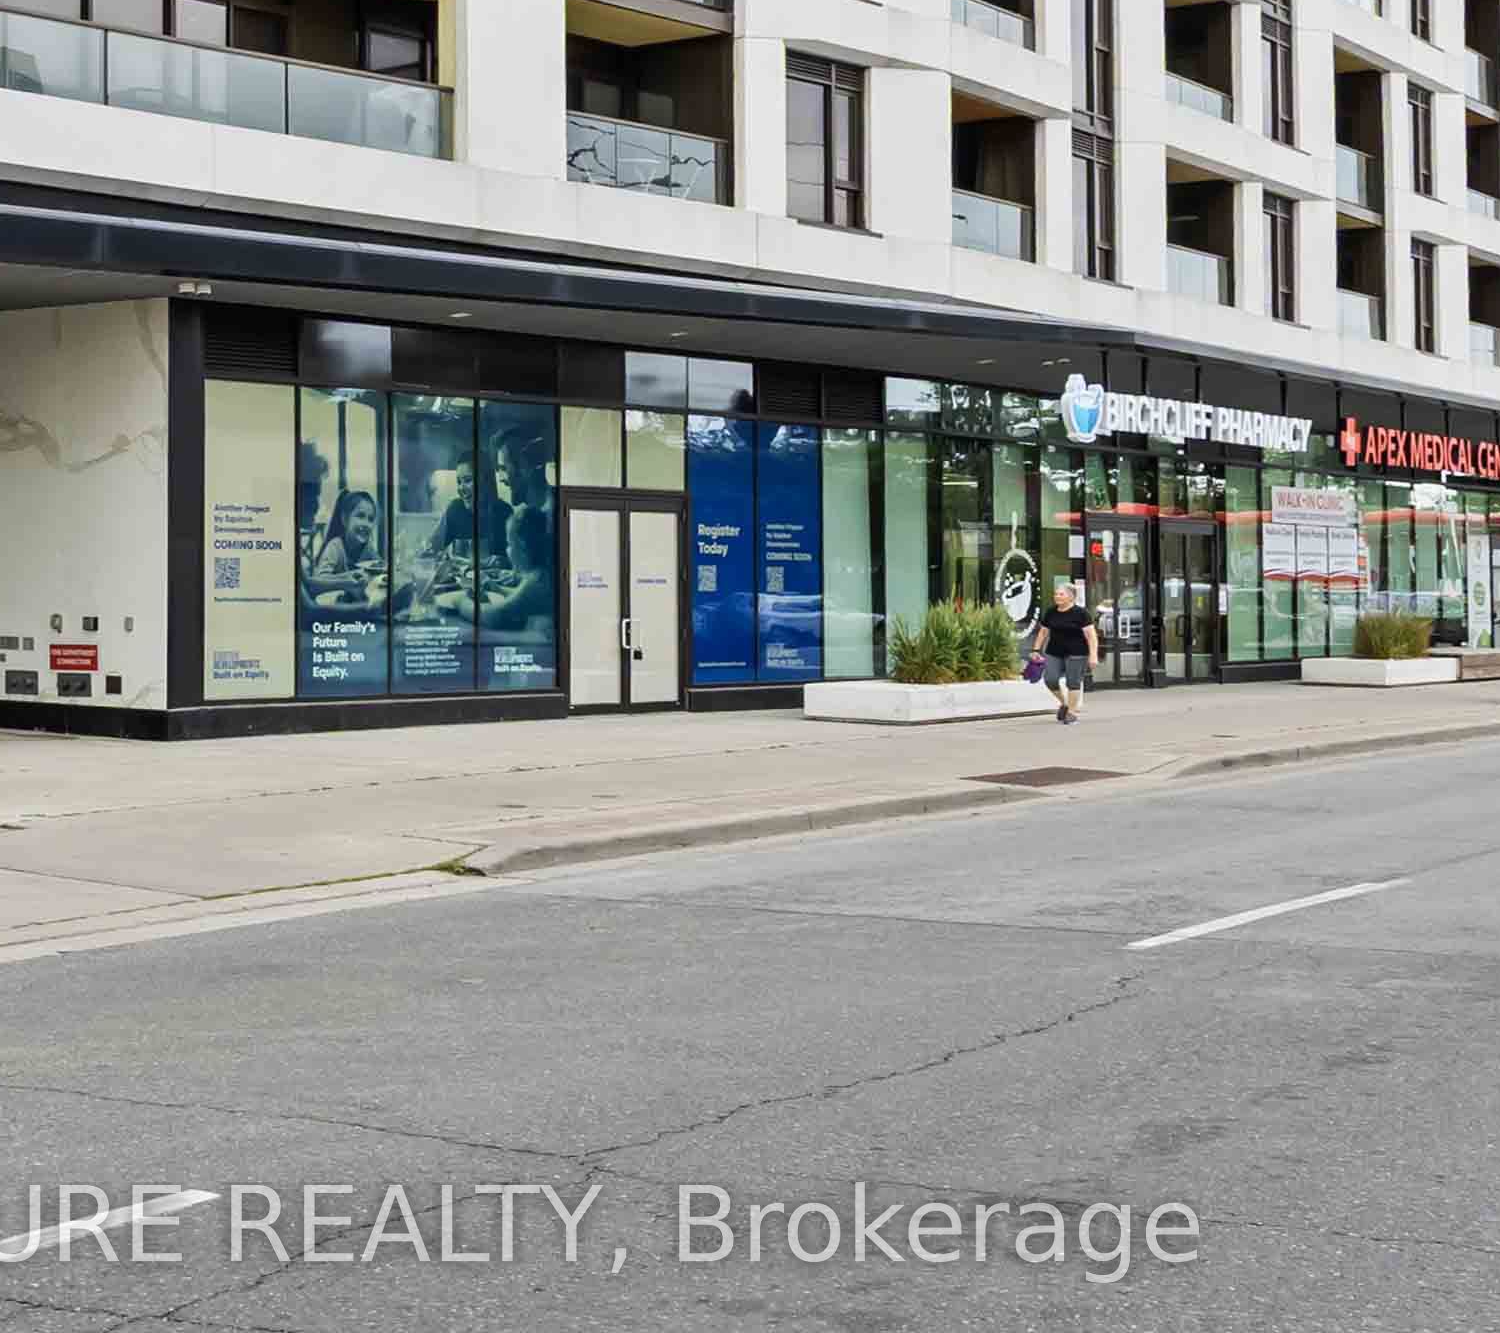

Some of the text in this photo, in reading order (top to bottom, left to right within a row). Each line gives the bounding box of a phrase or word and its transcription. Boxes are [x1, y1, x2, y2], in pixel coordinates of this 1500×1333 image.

[1106, 391, 1313, 452] BIRCHCLIFF PHARMACY
[1364, 425, 1408, 468] APEX
[1410, 432, 1475, 476] MEDICAL
[697, 523, 741, 539] Register
[214, 540, 282, 550] COMING SOON
[697, 541, 729, 557] Today
[312, 621, 377, 635] Our Family's
[312, 636, 348, 648] Future
[312, 650, 365, 662] Is Built on
[312, 665, 349, 681] Equity.
